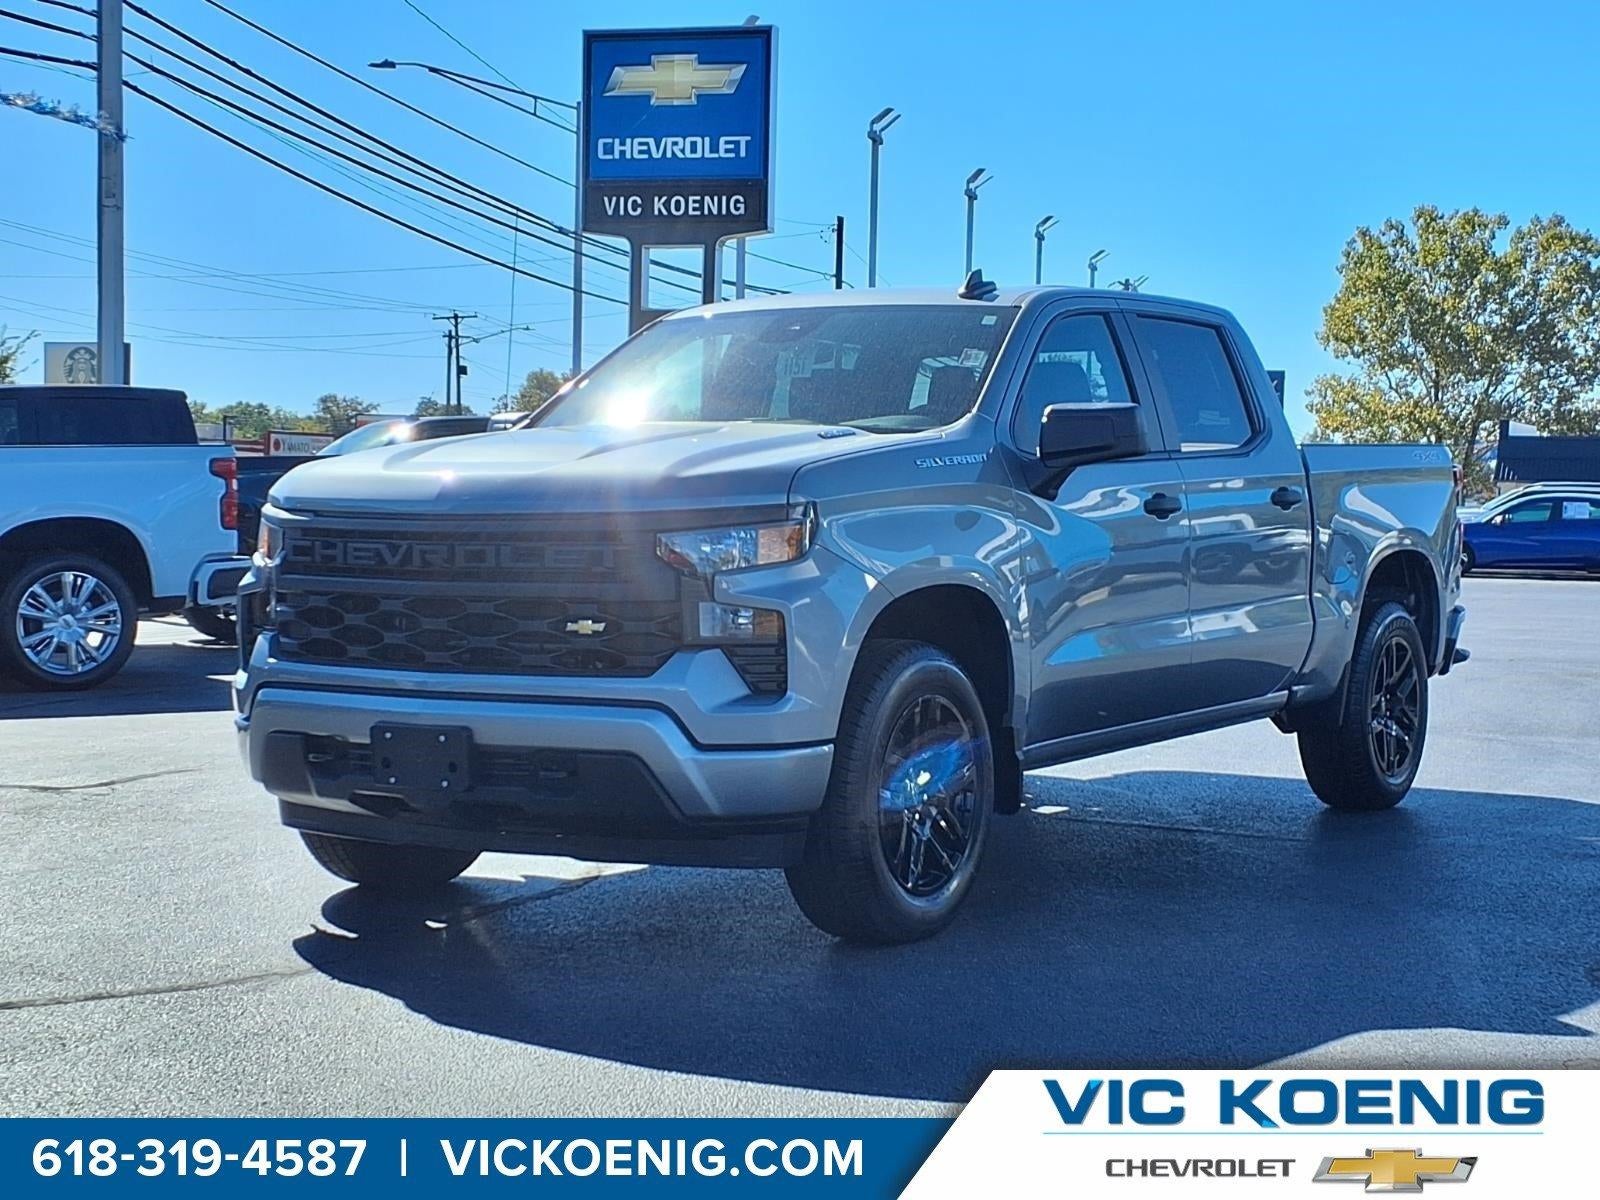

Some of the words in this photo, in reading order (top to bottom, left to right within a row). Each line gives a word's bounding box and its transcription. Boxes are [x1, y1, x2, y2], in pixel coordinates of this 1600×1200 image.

[597, 135, 752, 160] CHEVROLET
[603, 195, 643, 216] VIC
[653, 194, 746, 216] KOENIG
[285, 539, 618, 568] CHEVROLET
